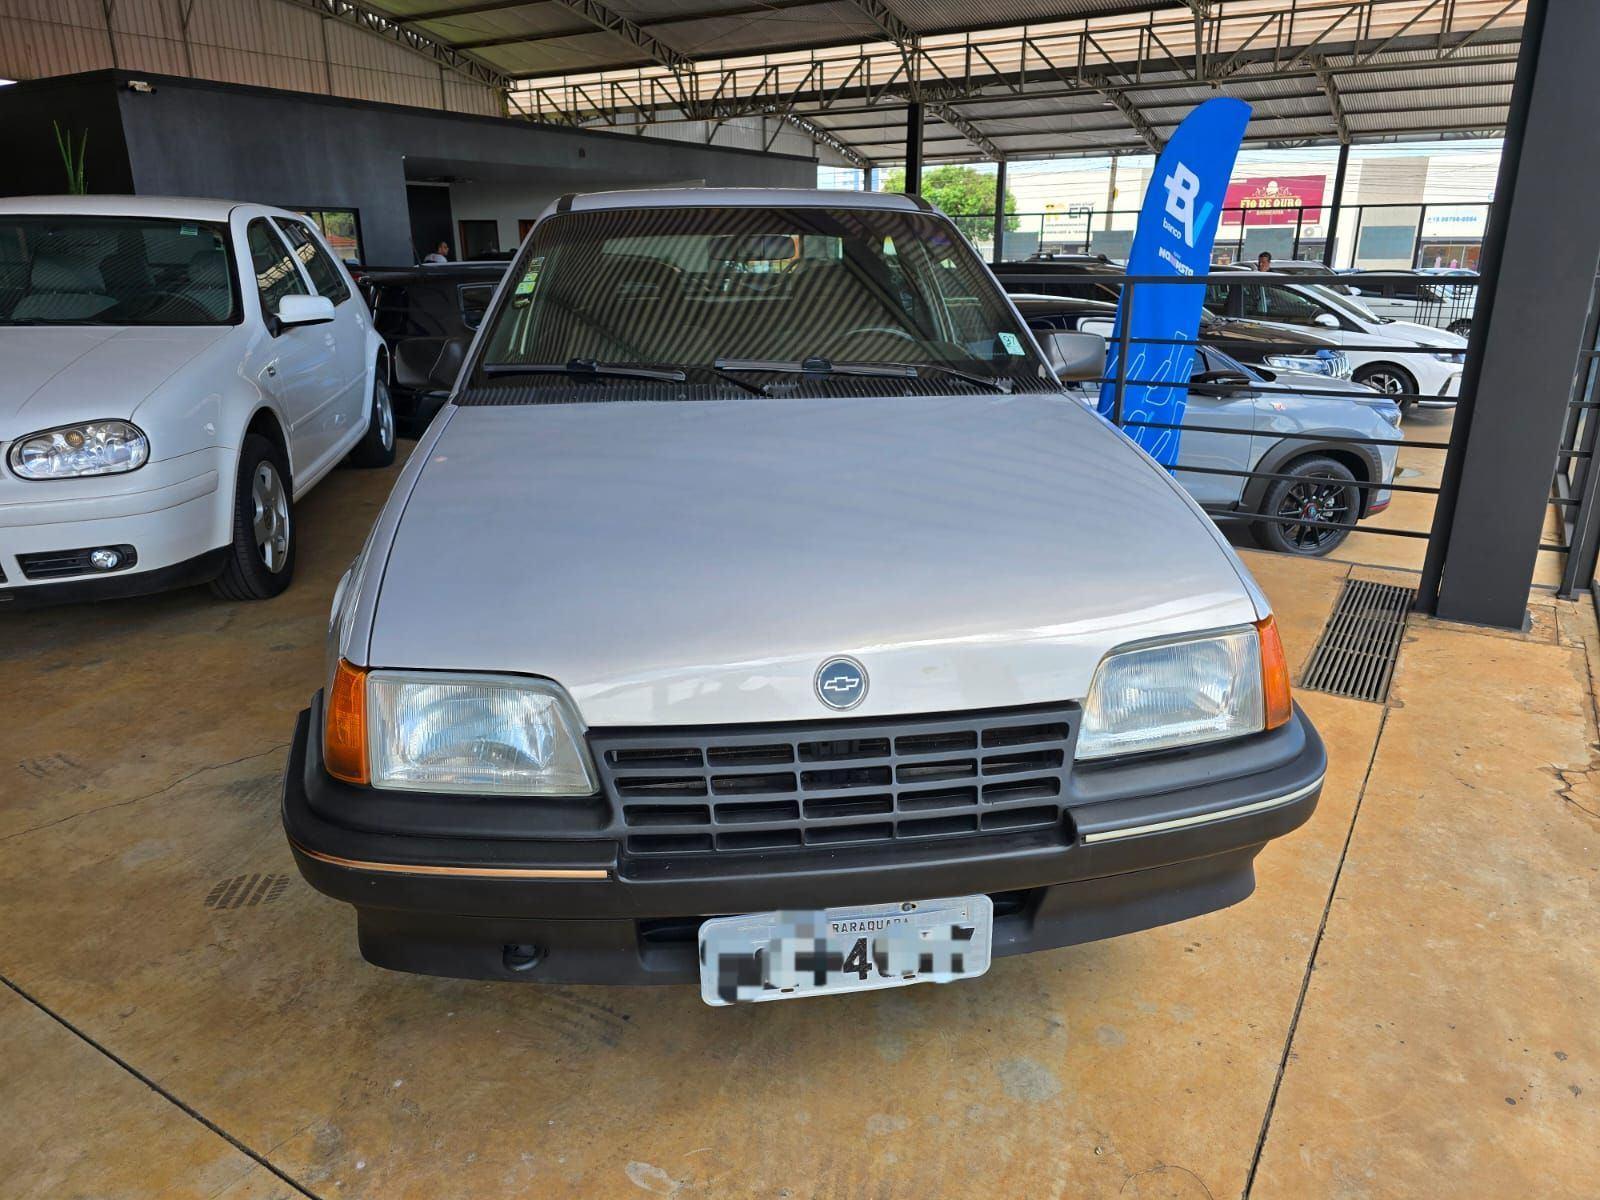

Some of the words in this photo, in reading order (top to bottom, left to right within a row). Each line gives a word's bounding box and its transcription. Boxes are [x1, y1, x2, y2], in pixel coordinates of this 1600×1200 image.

[1258, 198, 1272, 208] DE
[1273, 198, 1302, 208] OURO
[1162, 217, 1182, 240] banco
